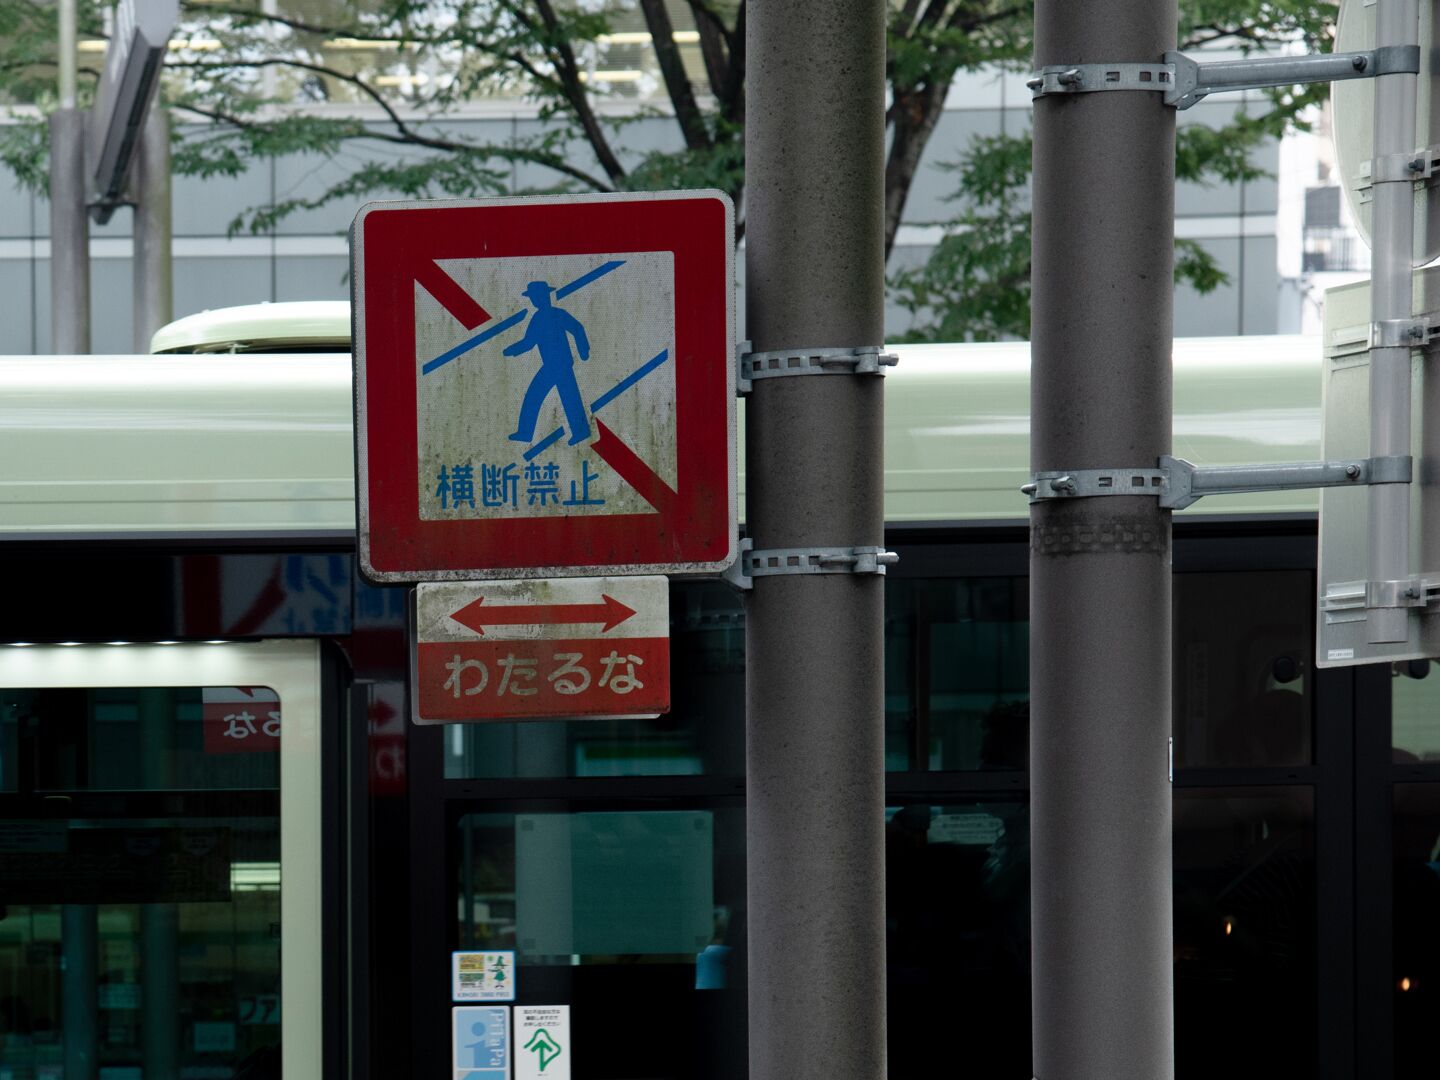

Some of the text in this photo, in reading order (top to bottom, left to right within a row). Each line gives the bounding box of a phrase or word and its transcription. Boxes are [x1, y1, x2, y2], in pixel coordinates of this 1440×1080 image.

[436, 461, 605, 509] 横断禁止
[443, 650, 644, 698] わたるな
